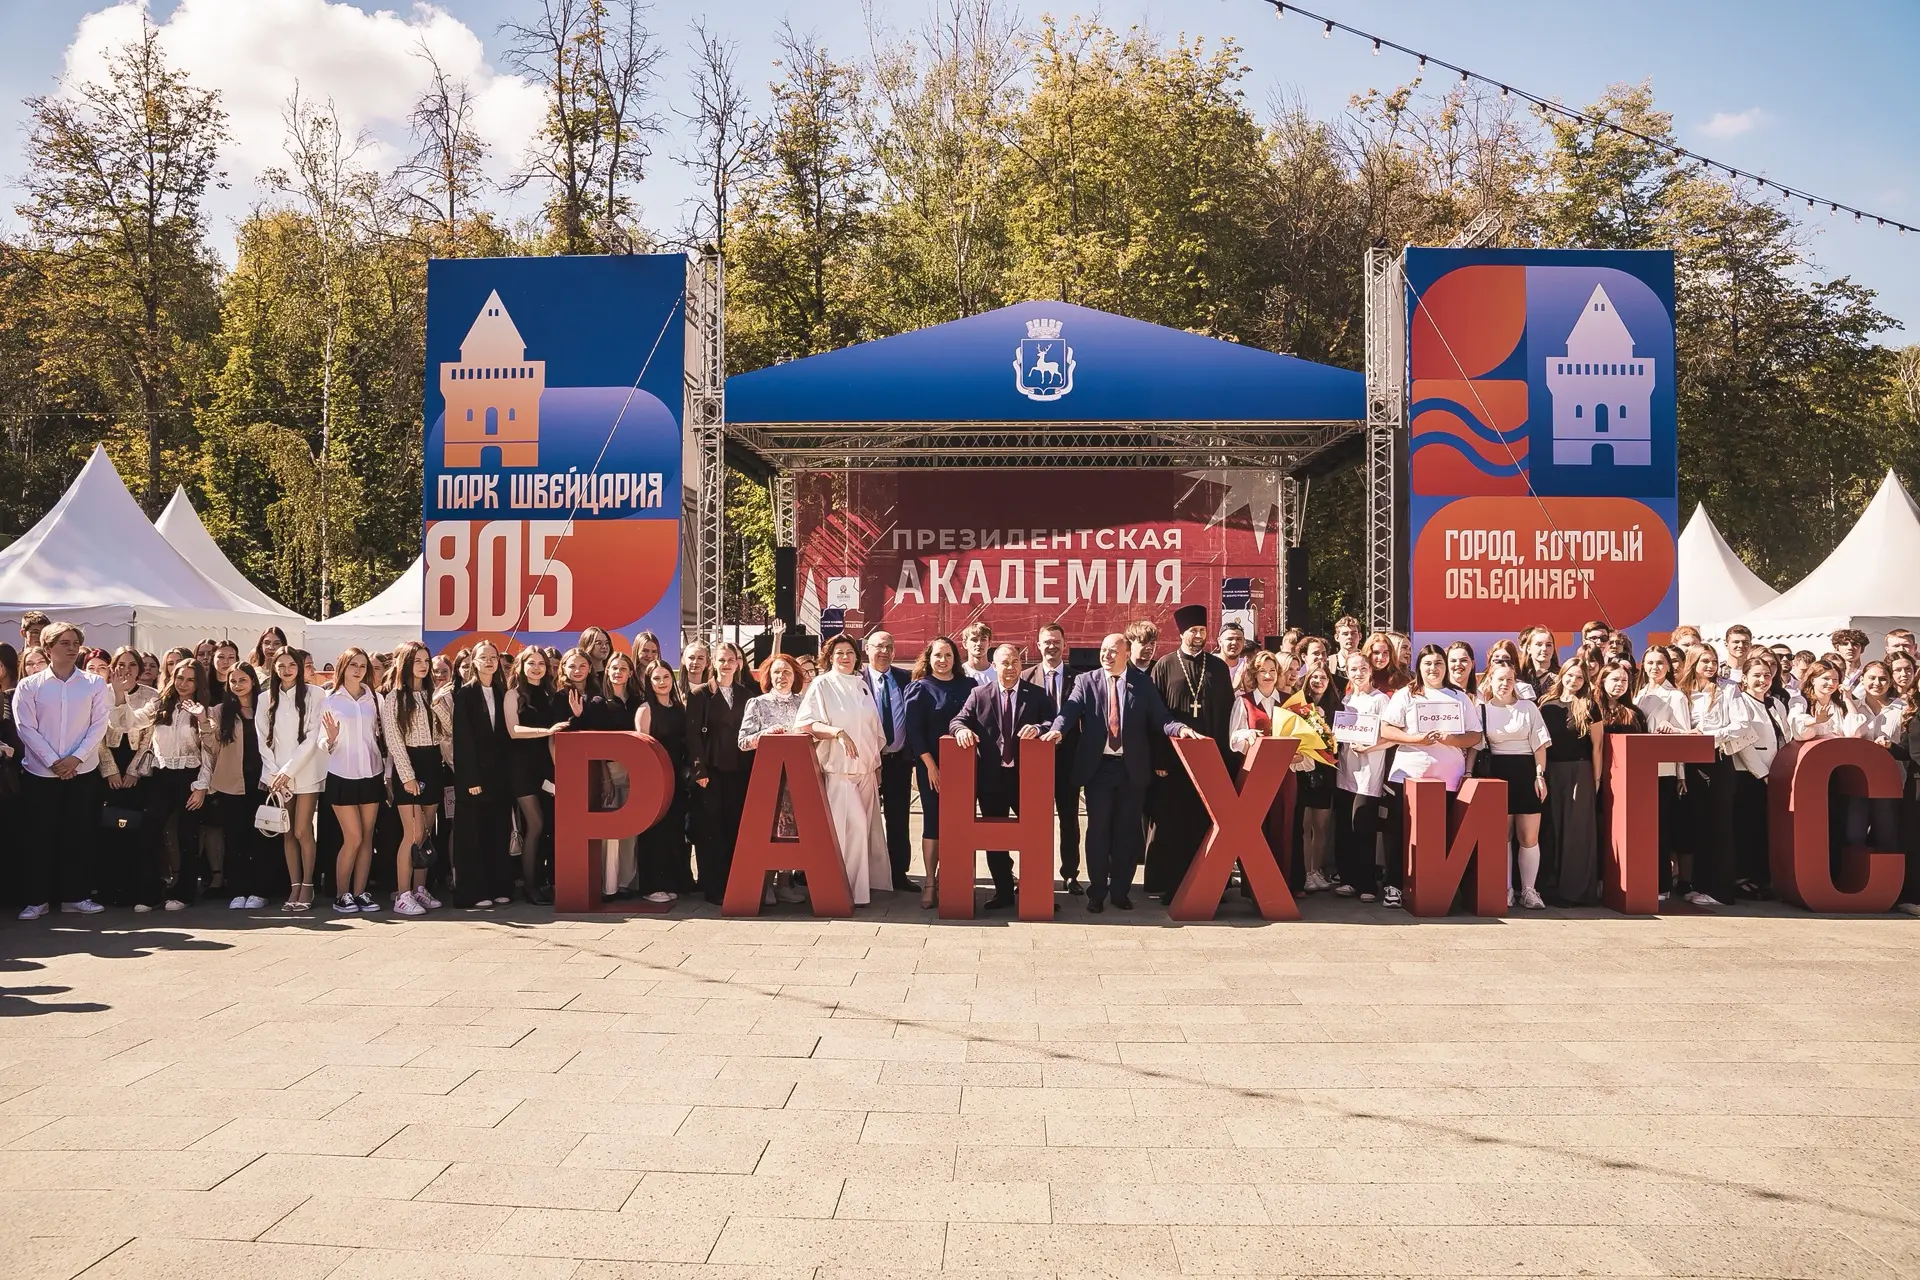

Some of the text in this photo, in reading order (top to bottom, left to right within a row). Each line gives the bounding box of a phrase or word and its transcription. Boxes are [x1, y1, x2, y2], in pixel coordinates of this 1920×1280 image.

[437, 466, 663, 515] ПАРК ШВЕЙЦАРИЯ
[892, 528, 1182, 550] ПРЕЗИДЕНТСКАЯ
[1445, 523, 1643, 566] ГОРОД, КОТОРЫЙ
[424, 520, 574, 632] 805
[894, 558, 1182, 604] АКАДЕМИЯ
[1445, 567, 1595, 605] ОБЪЕДИНЯЕТ
